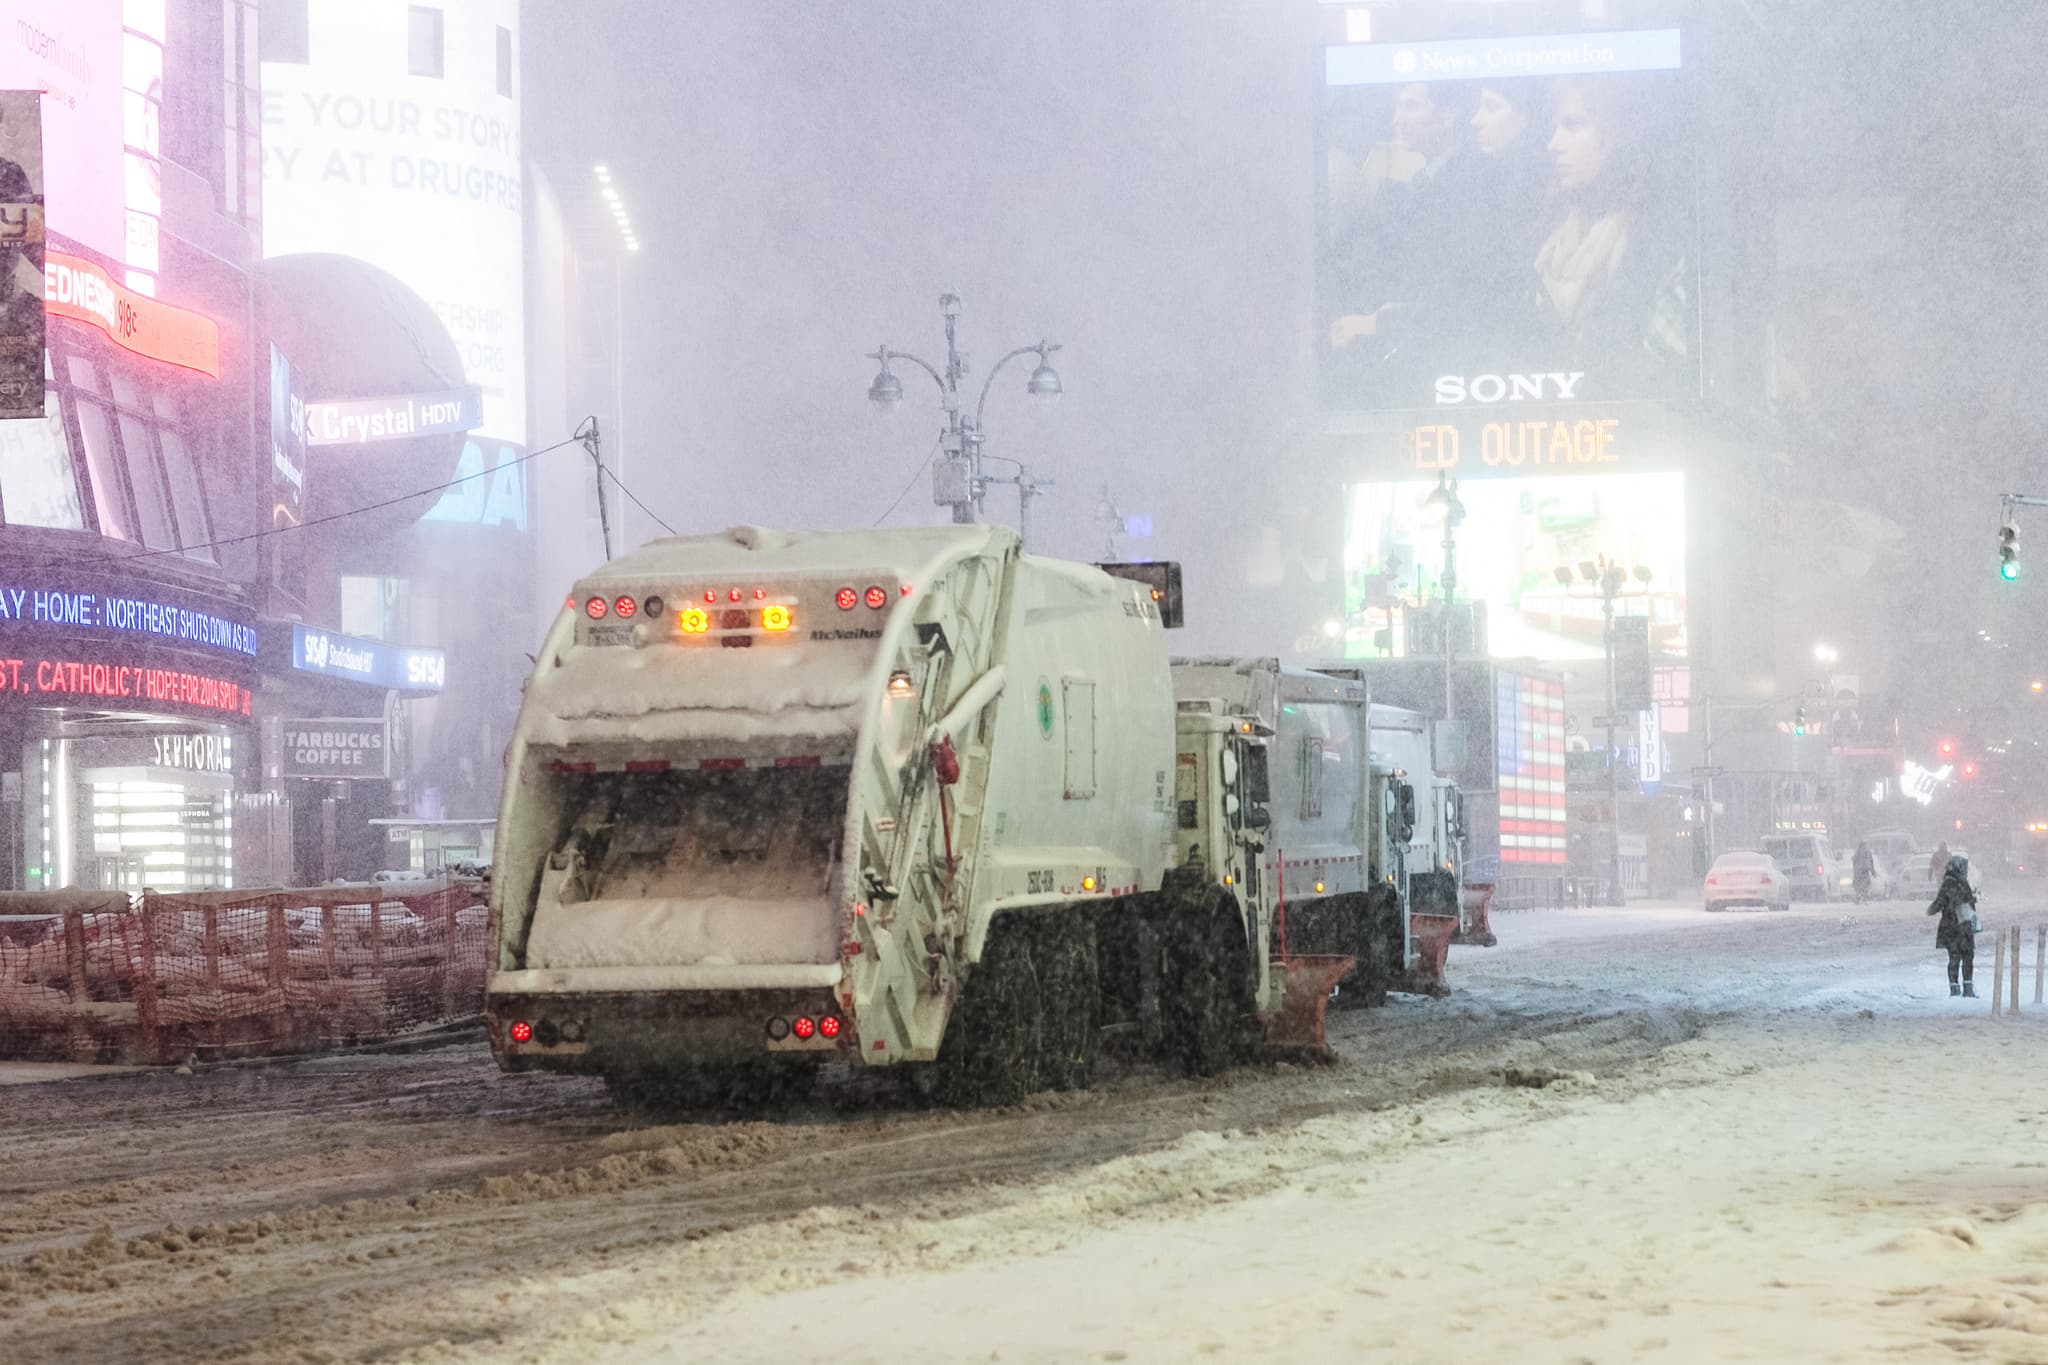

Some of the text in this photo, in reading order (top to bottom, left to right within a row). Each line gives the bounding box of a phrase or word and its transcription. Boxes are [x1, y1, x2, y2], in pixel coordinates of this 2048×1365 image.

[301, 92, 420, 136] YOUR
[319, 148, 375, 186] AT
[1434, 371, 1584, 404] SONY
[322, 402, 415, 442] Crystal
[422, 401, 462, 427] HDTV
[1481, 419, 1619, 466] OUTAGE
[106, 598, 177, 636] NORTHEAST
[179, 609, 207, 642] SHUTS
[209, 617, 230, 648] DOWN
[231, 623, 242, 652] AS
[37, 660, 129, 696] CATHOLIC
[134, 667, 143, 697] 7
[146, 669, 178, 702] HOPE
[180, 672, 200, 705] FOR
[199, 677, 218, 708] 2014
[154, 735, 224, 772] SEPHORA
[295, 749, 363, 765] COFFEE
[1644, 703, 1656, 778] NYPD
[391, 829, 407, 839] ATM
